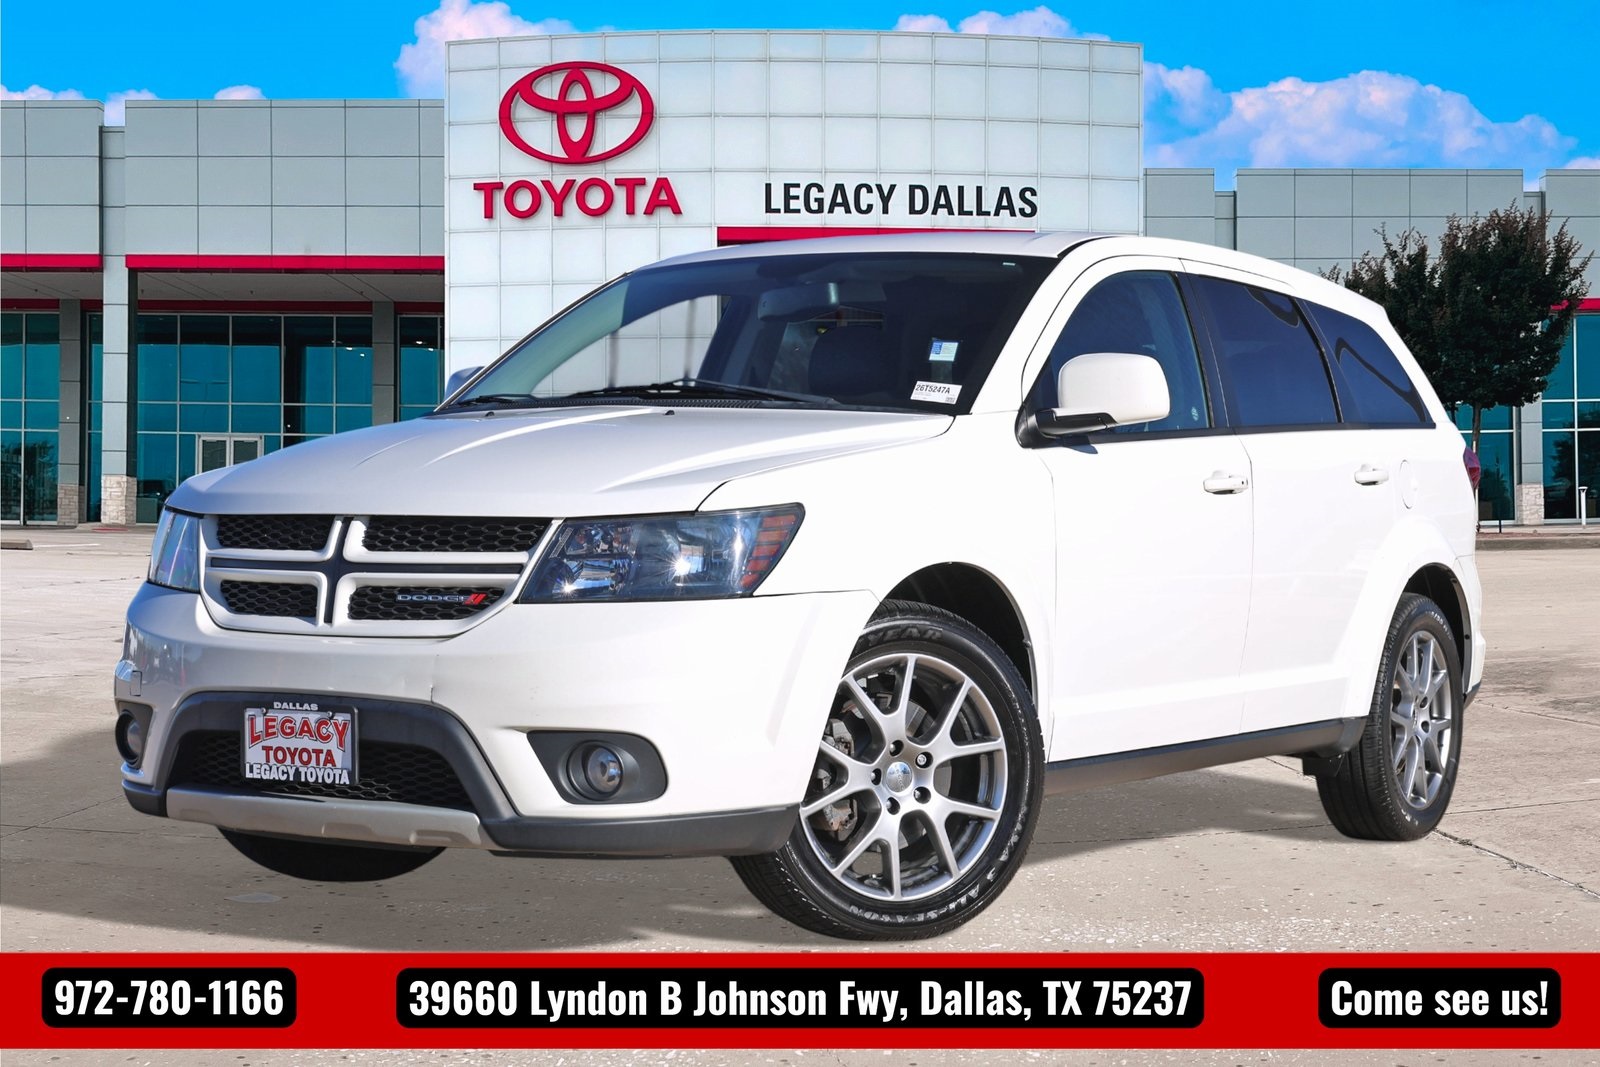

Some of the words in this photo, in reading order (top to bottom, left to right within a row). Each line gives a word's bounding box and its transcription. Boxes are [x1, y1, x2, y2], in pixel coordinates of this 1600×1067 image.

[474, 177, 683, 219] TOYOTA
[765, 182, 897, 215] LEGACY
[908, 184, 1038, 218] DALLAS
[915, 384, 951, 394] 26T5247A
[273, 701, 319, 711] DALLAS
[248, 714, 351, 752] LEGACY
[261, 745, 337, 767] TOYOTA
[245, 762, 297, 781] LEGACY
[299, 766, 350, 785] TOYOTA
